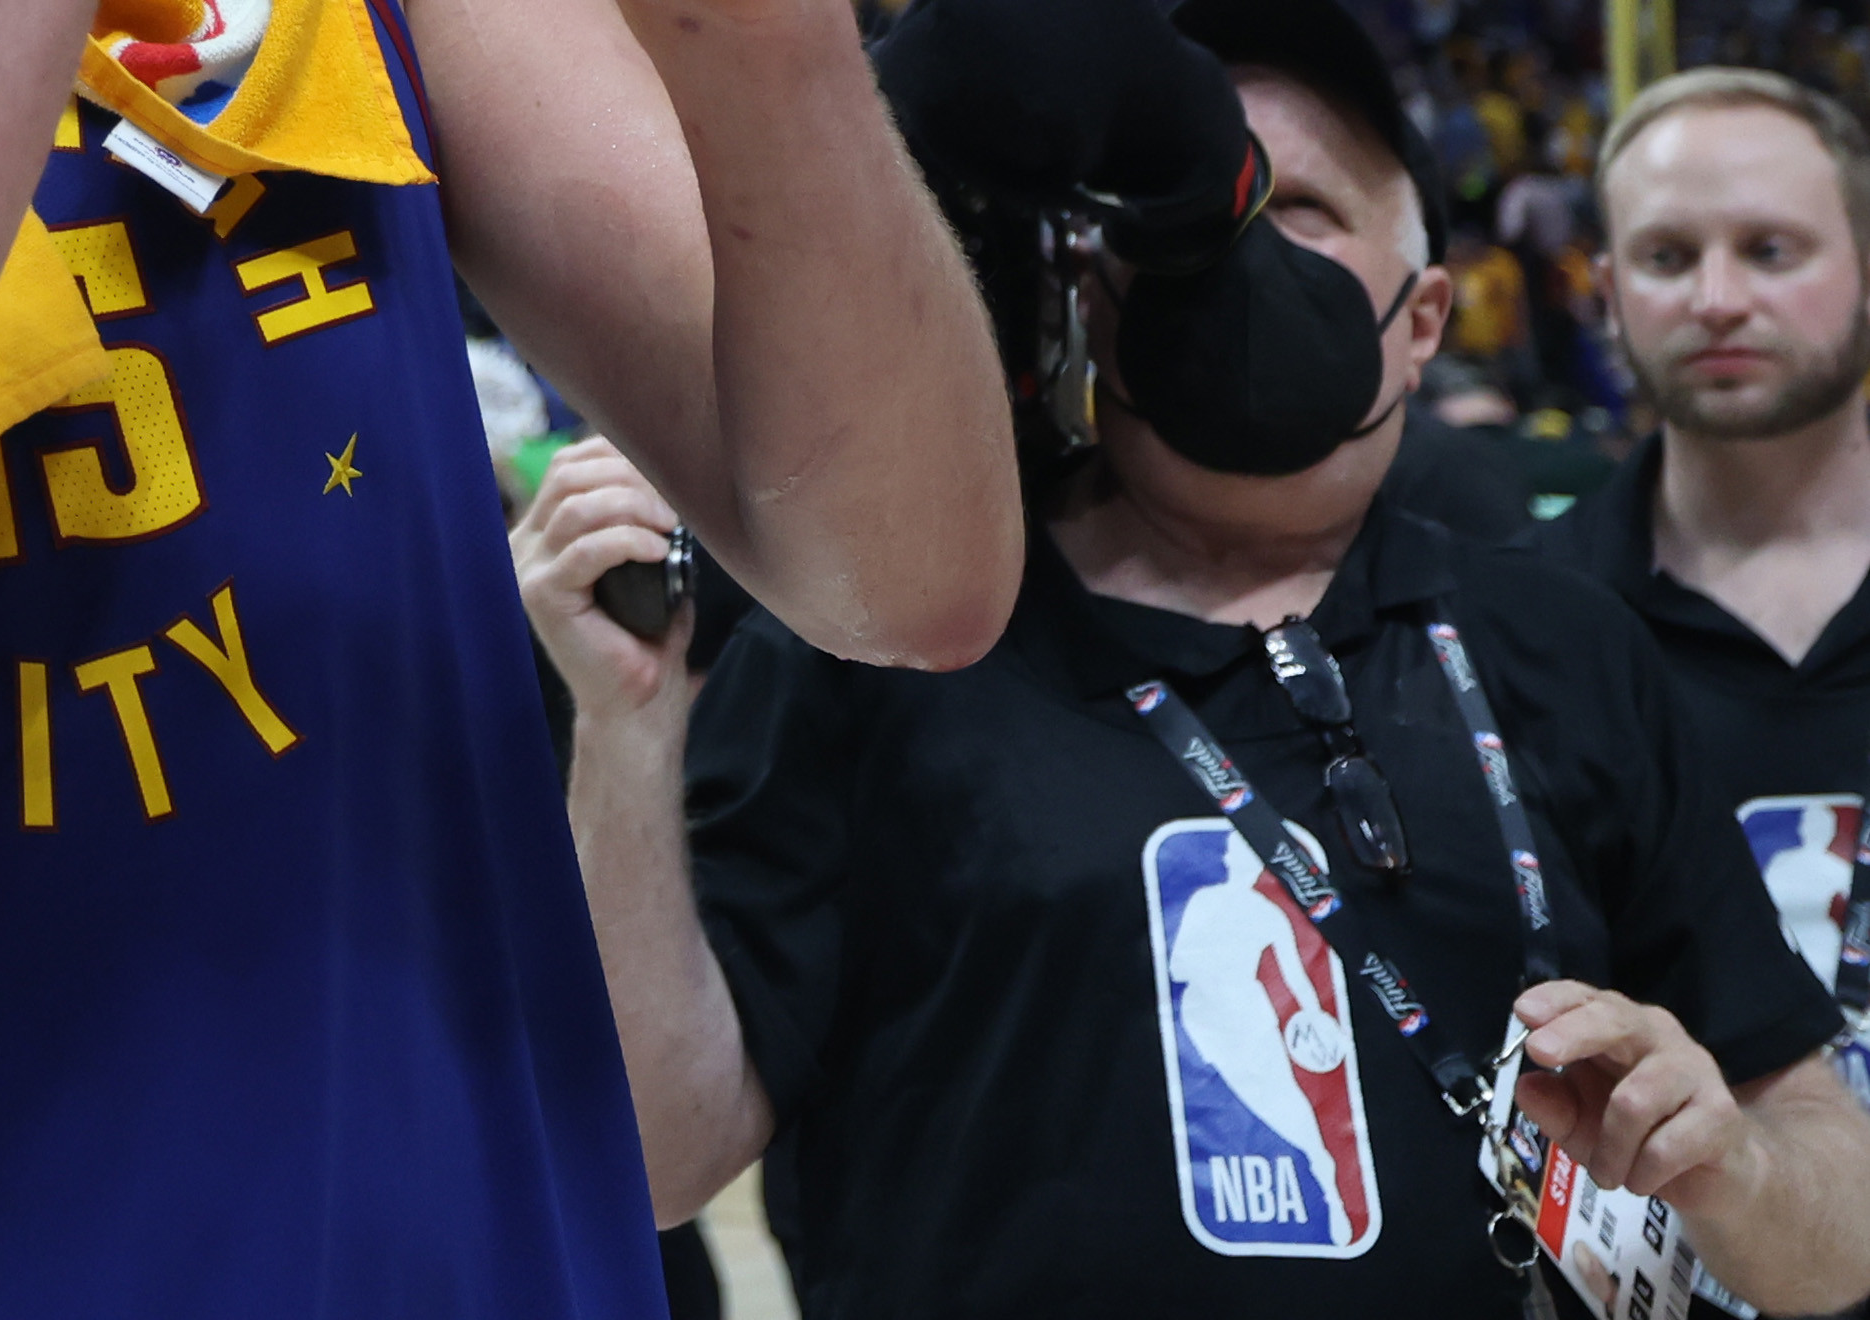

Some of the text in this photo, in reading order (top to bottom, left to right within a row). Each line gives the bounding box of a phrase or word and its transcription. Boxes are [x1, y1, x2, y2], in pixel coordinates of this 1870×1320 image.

[1183, 737, 1250, 799] Finals
[1270, 841, 1339, 909] Finals
[1360, 951, 1426, 1020] Finals
[1209, 1154, 1309, 1224] NBA
